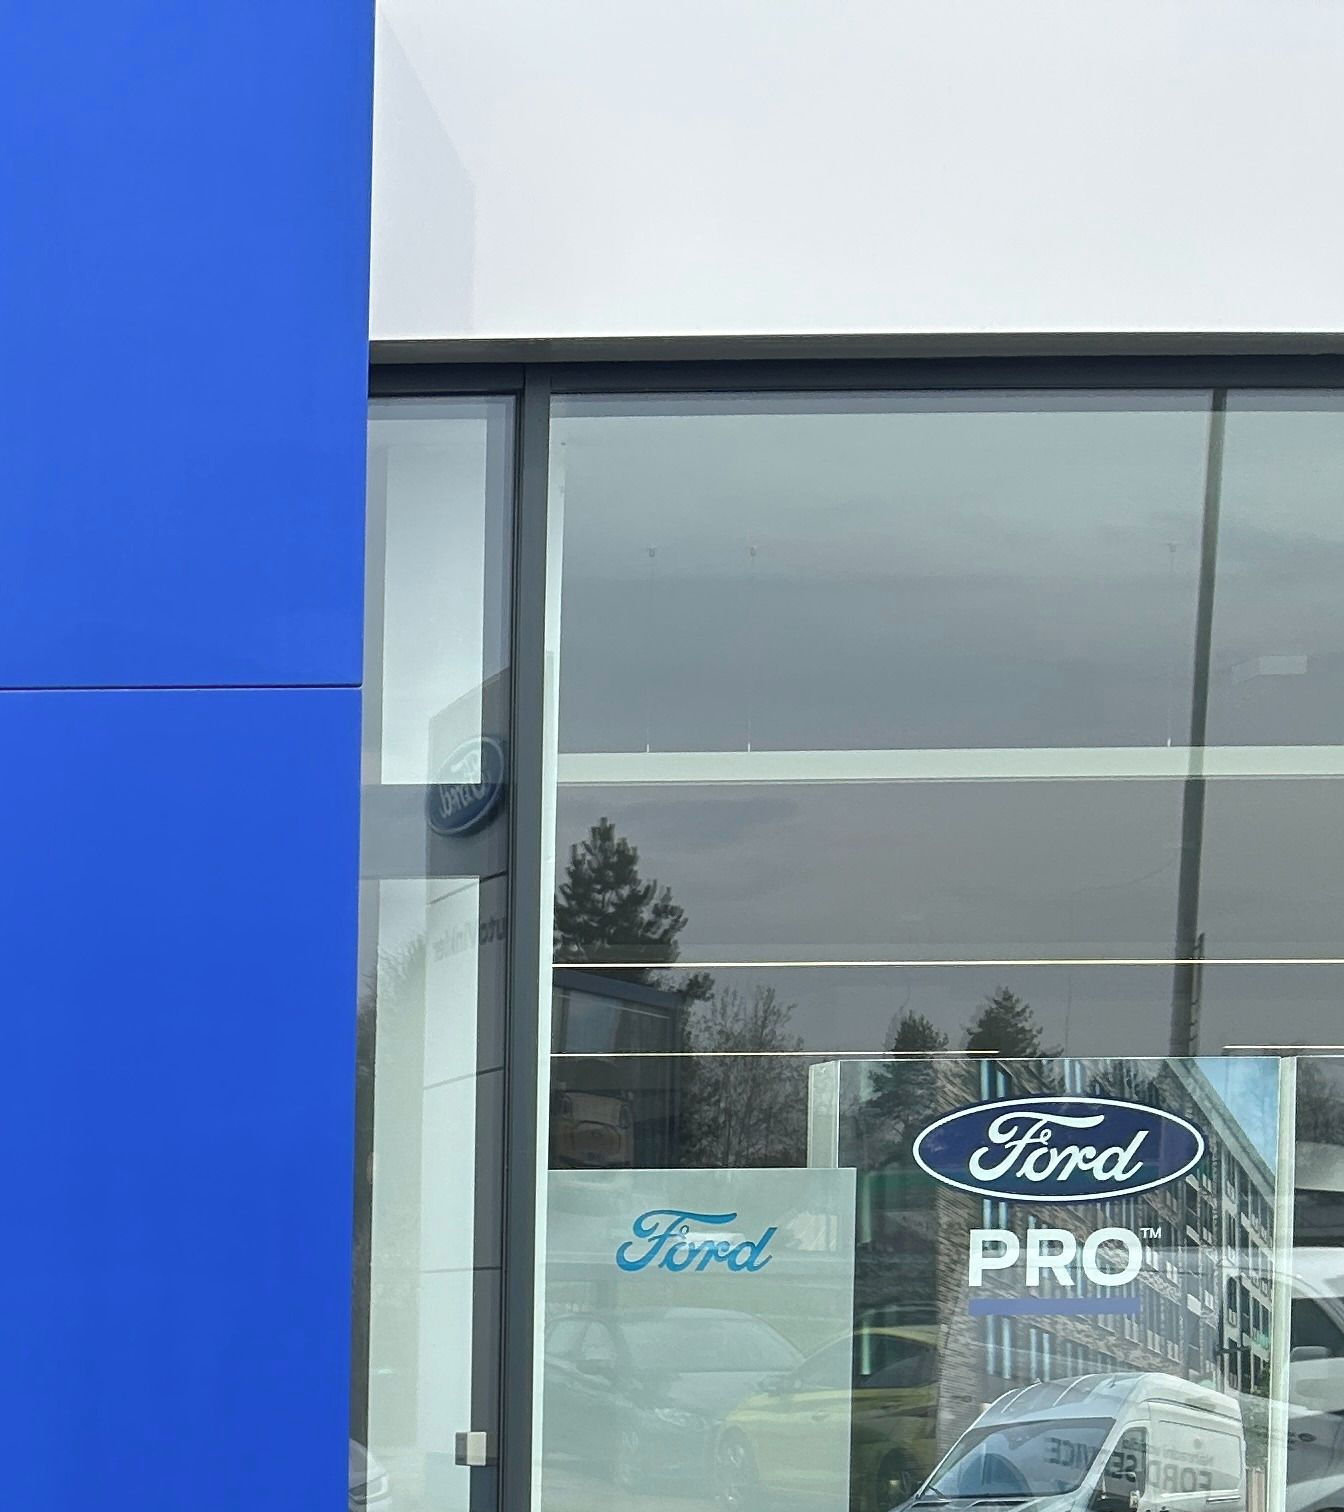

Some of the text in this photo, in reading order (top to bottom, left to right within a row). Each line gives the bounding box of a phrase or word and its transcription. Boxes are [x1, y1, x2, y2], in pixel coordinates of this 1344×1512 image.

[969, 1111, 1150, 1182] Ford
[616, 1209, 778, 1272] Ford
[968, 1227, 1143, 1287] PRO
